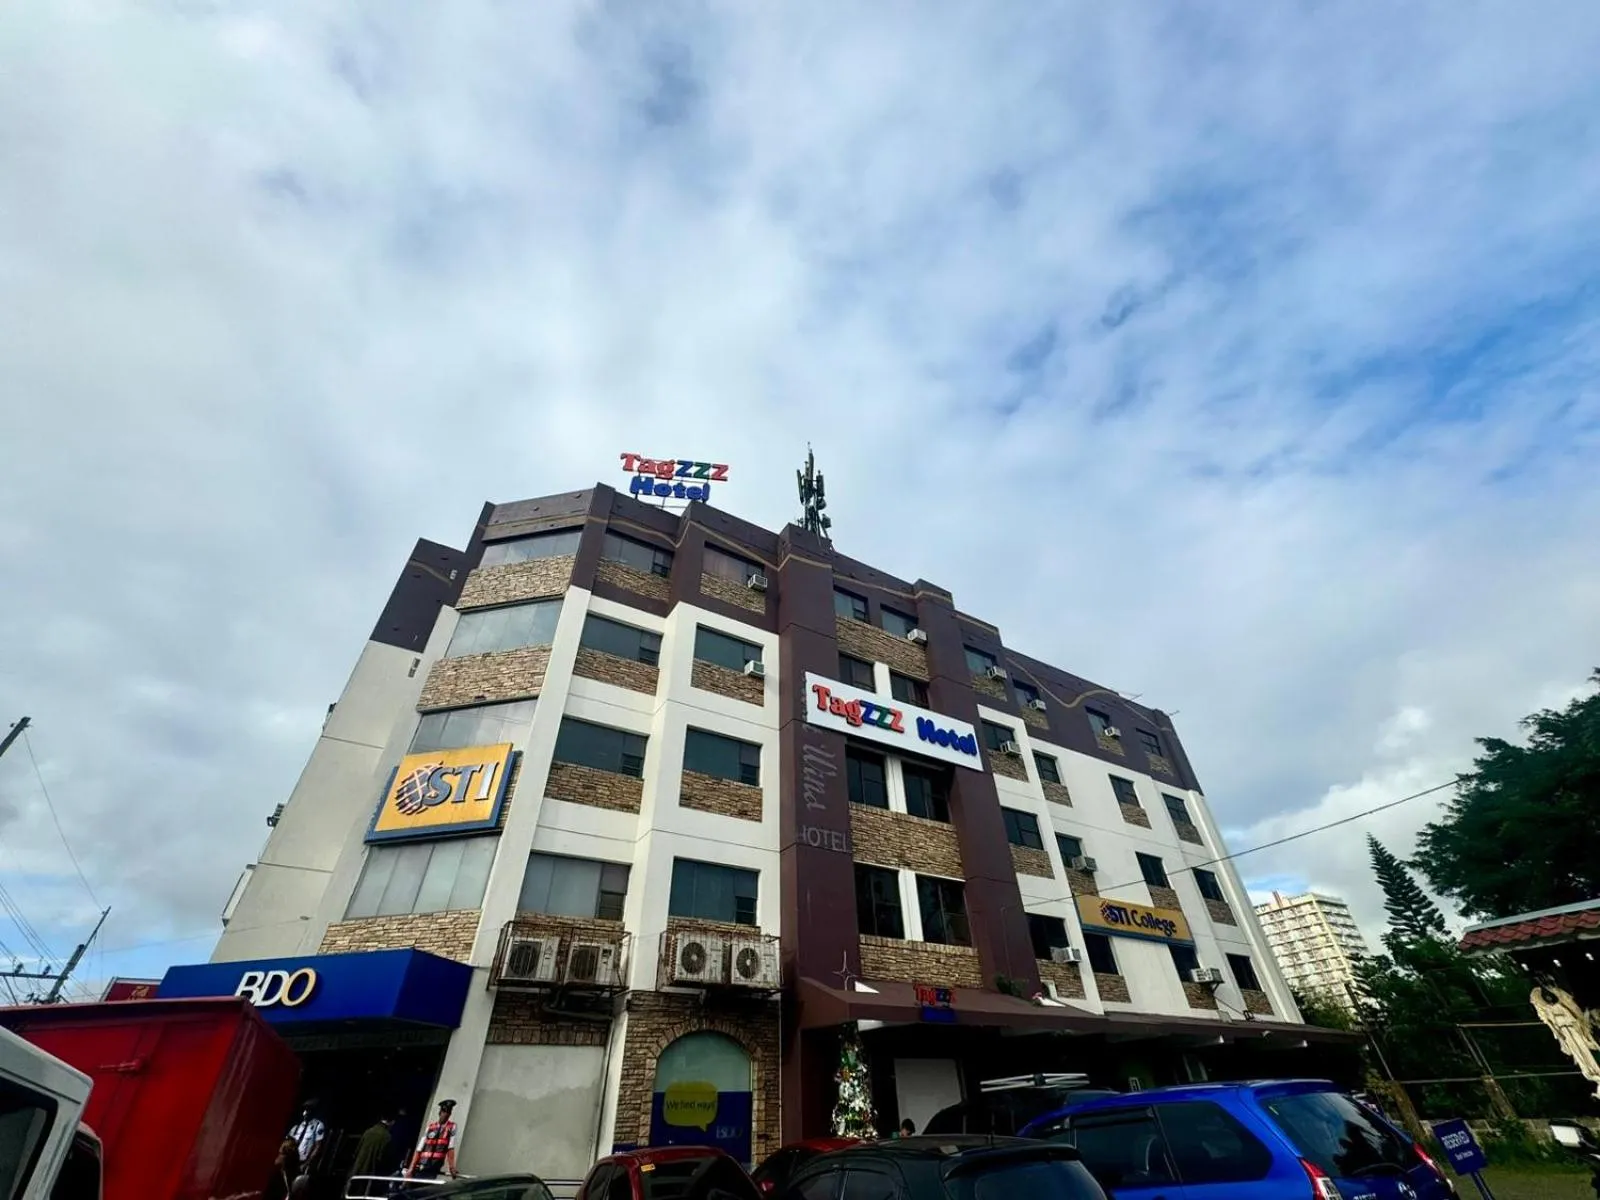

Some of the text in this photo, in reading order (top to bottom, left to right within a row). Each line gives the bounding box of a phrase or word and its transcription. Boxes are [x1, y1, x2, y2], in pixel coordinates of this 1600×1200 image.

[629, 476, 710, 501] Hotel
[916, 716, 978, 756] Hotel
[422, 762, 500, 807] STI
[1109, 904, 1178, 937] STI College
[234, 967, 317, 1007] BDO
